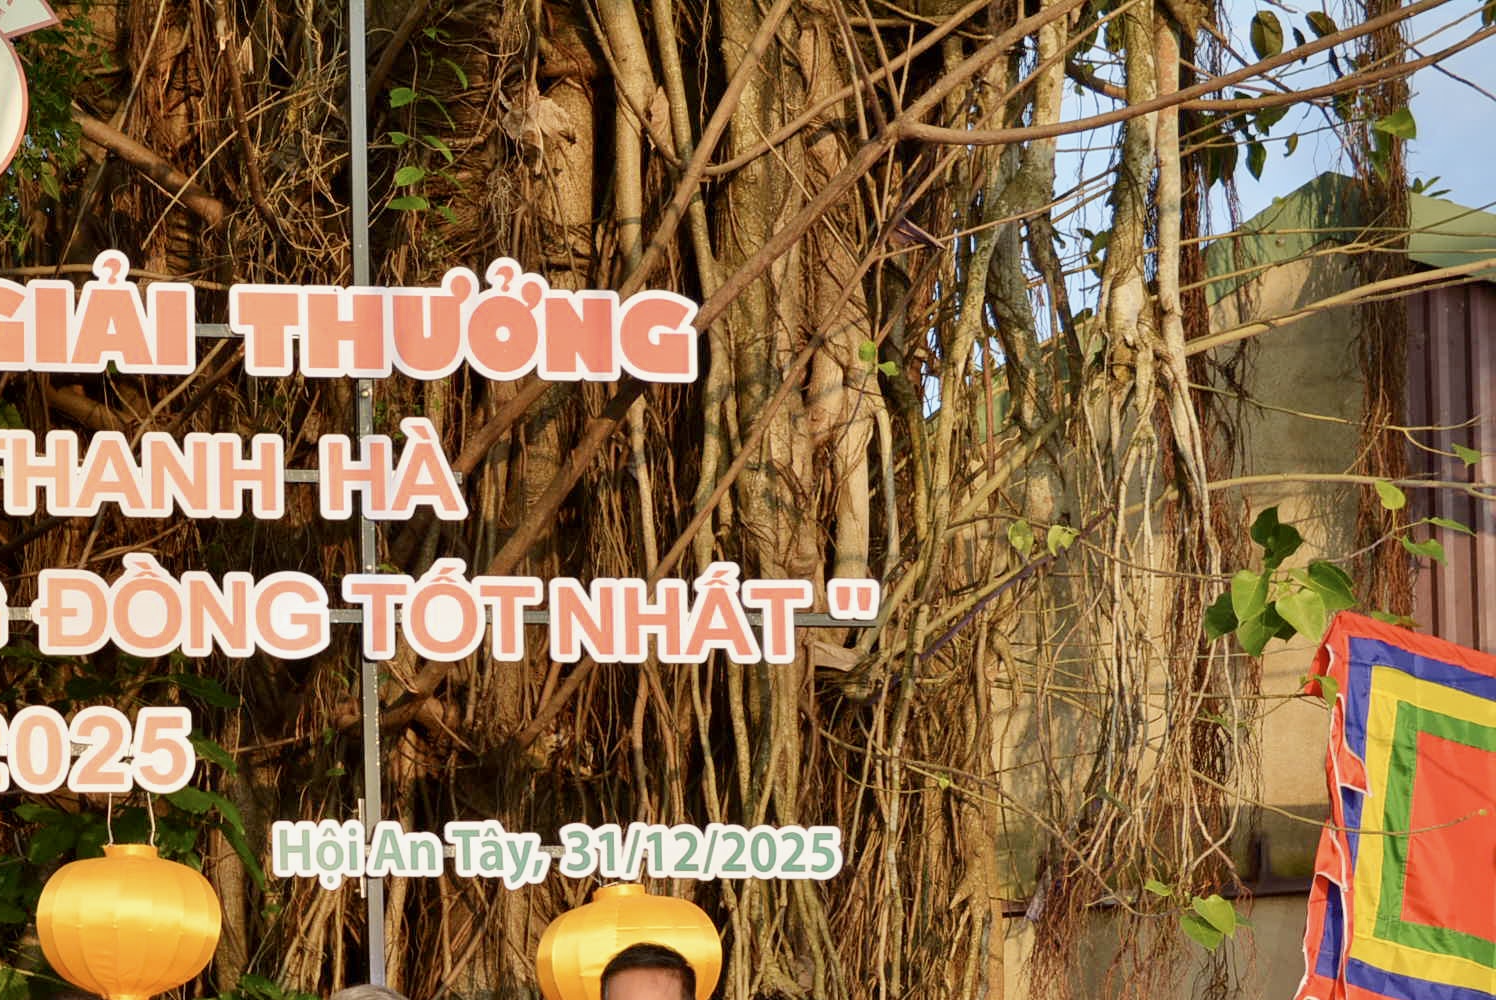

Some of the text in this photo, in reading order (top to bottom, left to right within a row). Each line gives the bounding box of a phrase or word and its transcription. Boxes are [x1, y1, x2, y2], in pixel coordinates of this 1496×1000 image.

[229, 257, 698, 383] THƯỞNG
[319, 417, 468, 520] HÀ
[31, 552, 330, 660] ĐỒNG
[343, 557, 543, 662] TỐT
[272, 820, 842, 890] Hội An Tây, 31/12/2025
